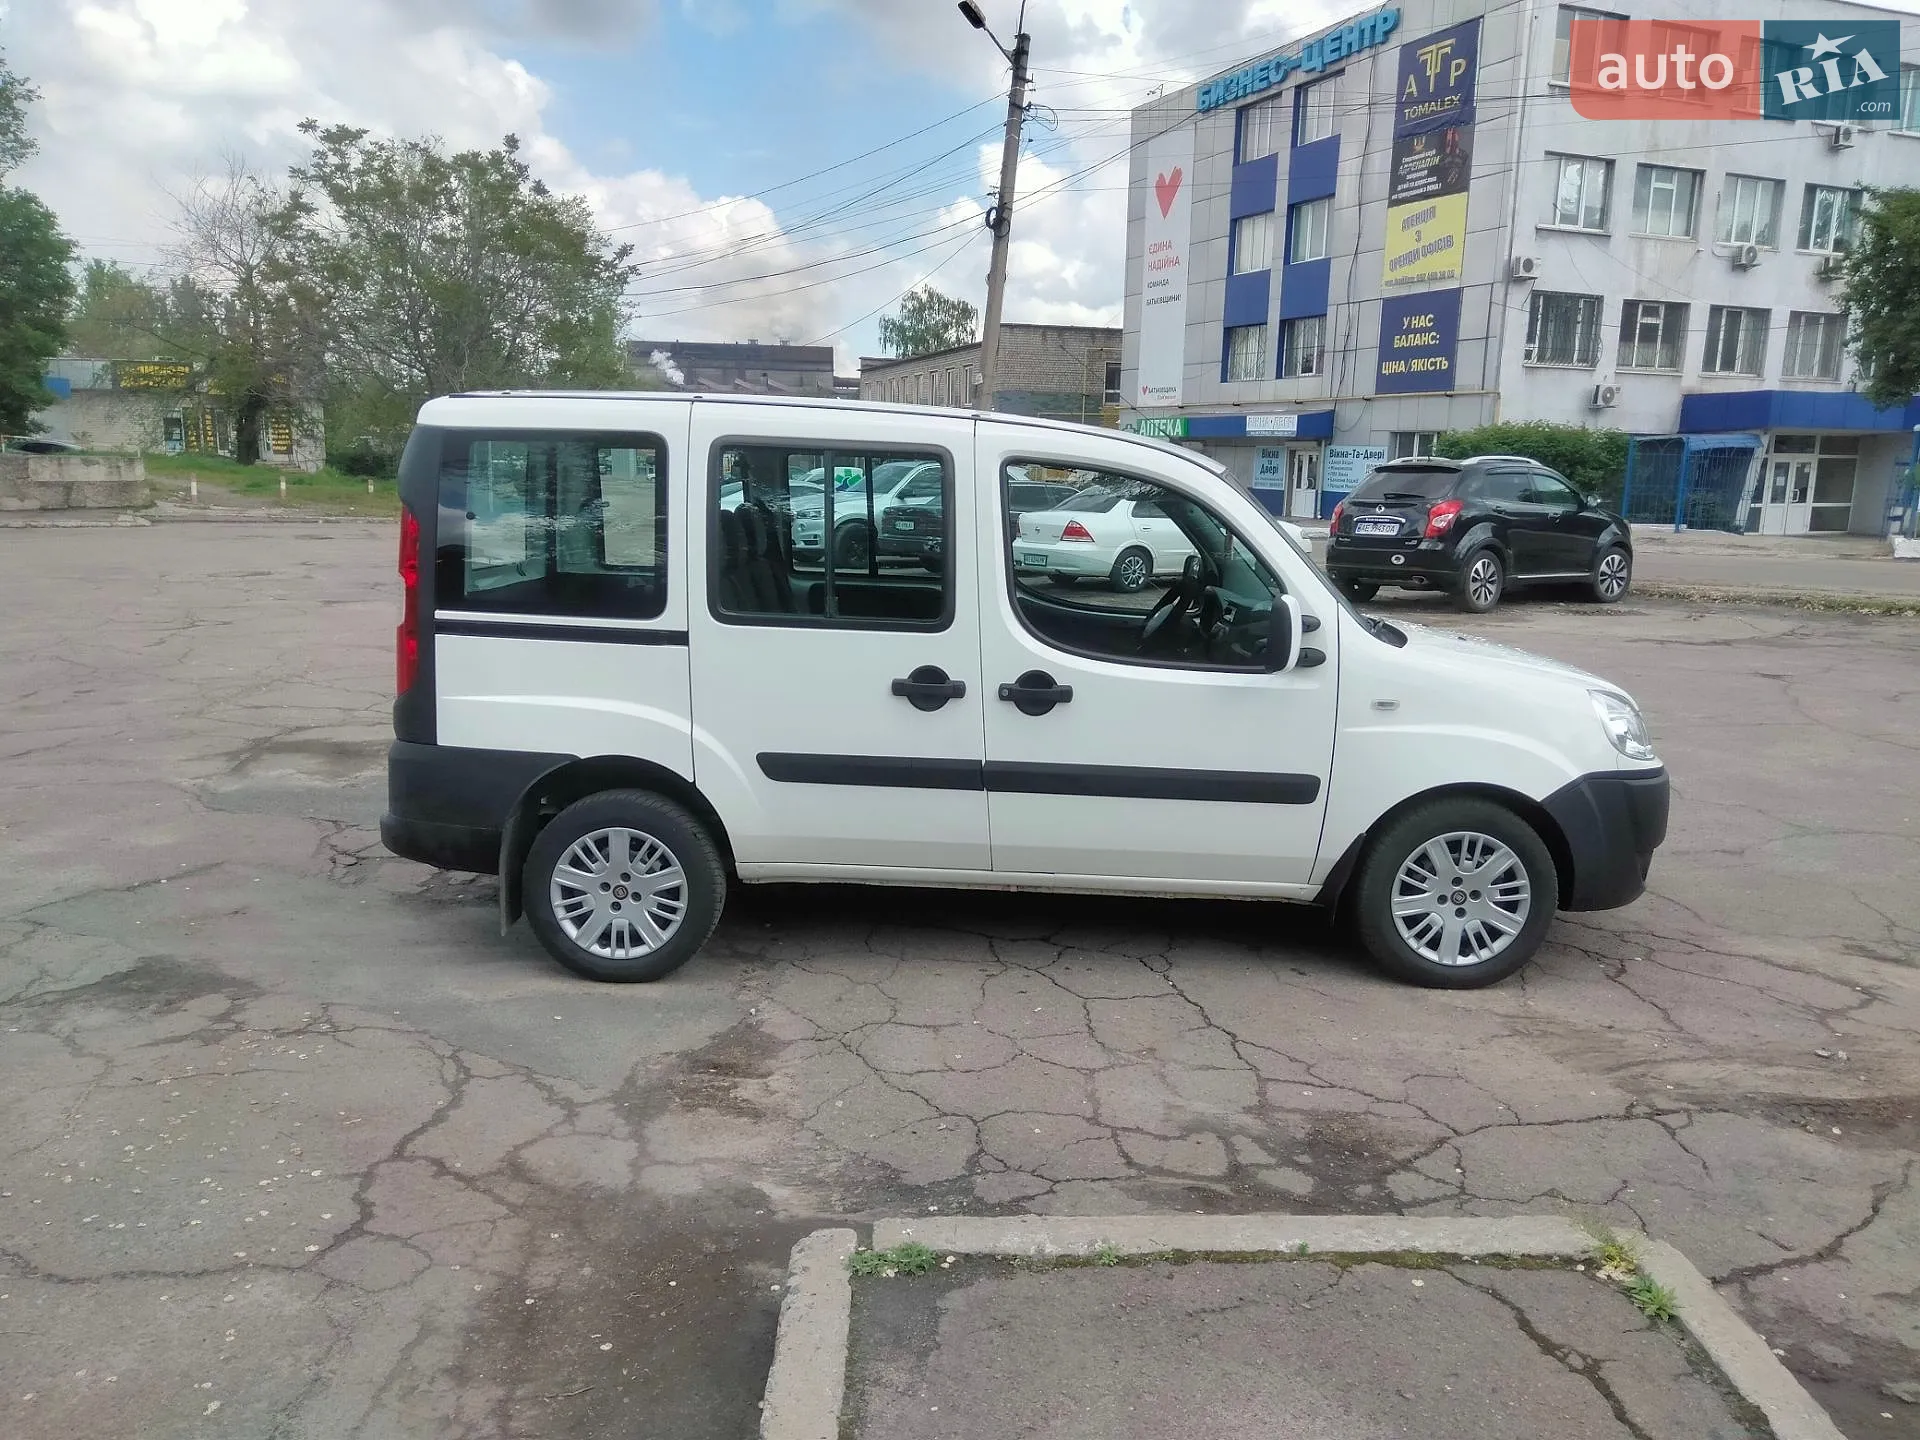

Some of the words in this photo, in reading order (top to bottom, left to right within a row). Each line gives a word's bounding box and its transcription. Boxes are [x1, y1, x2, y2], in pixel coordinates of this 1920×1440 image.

[1197, 8, 1400, 112] БИЗНЕС-ЦЕНТР
[1404, 93, 1461, 120] TOMALEX
[1149, 240, 1172, 255] ЄДИНА
[1148, 255, 1180, 272] НАДІЙНА
[1403, 316, 1409, 329] У
[1411, 314, 1434, 328] НАС
[1394, 331, 1440, 348] БАЛАНС:
[1382, 356, 1448, 375] ЦІНА/ЯКІСТЬ
[1140, 418, 1182, 437] АПТЕКА
[1261, 448, 1280, 459] Вікна
[1329, 448, 1385, 461] Вікна-Та-Двері
[1259, 463, 1279, 476] Двері
